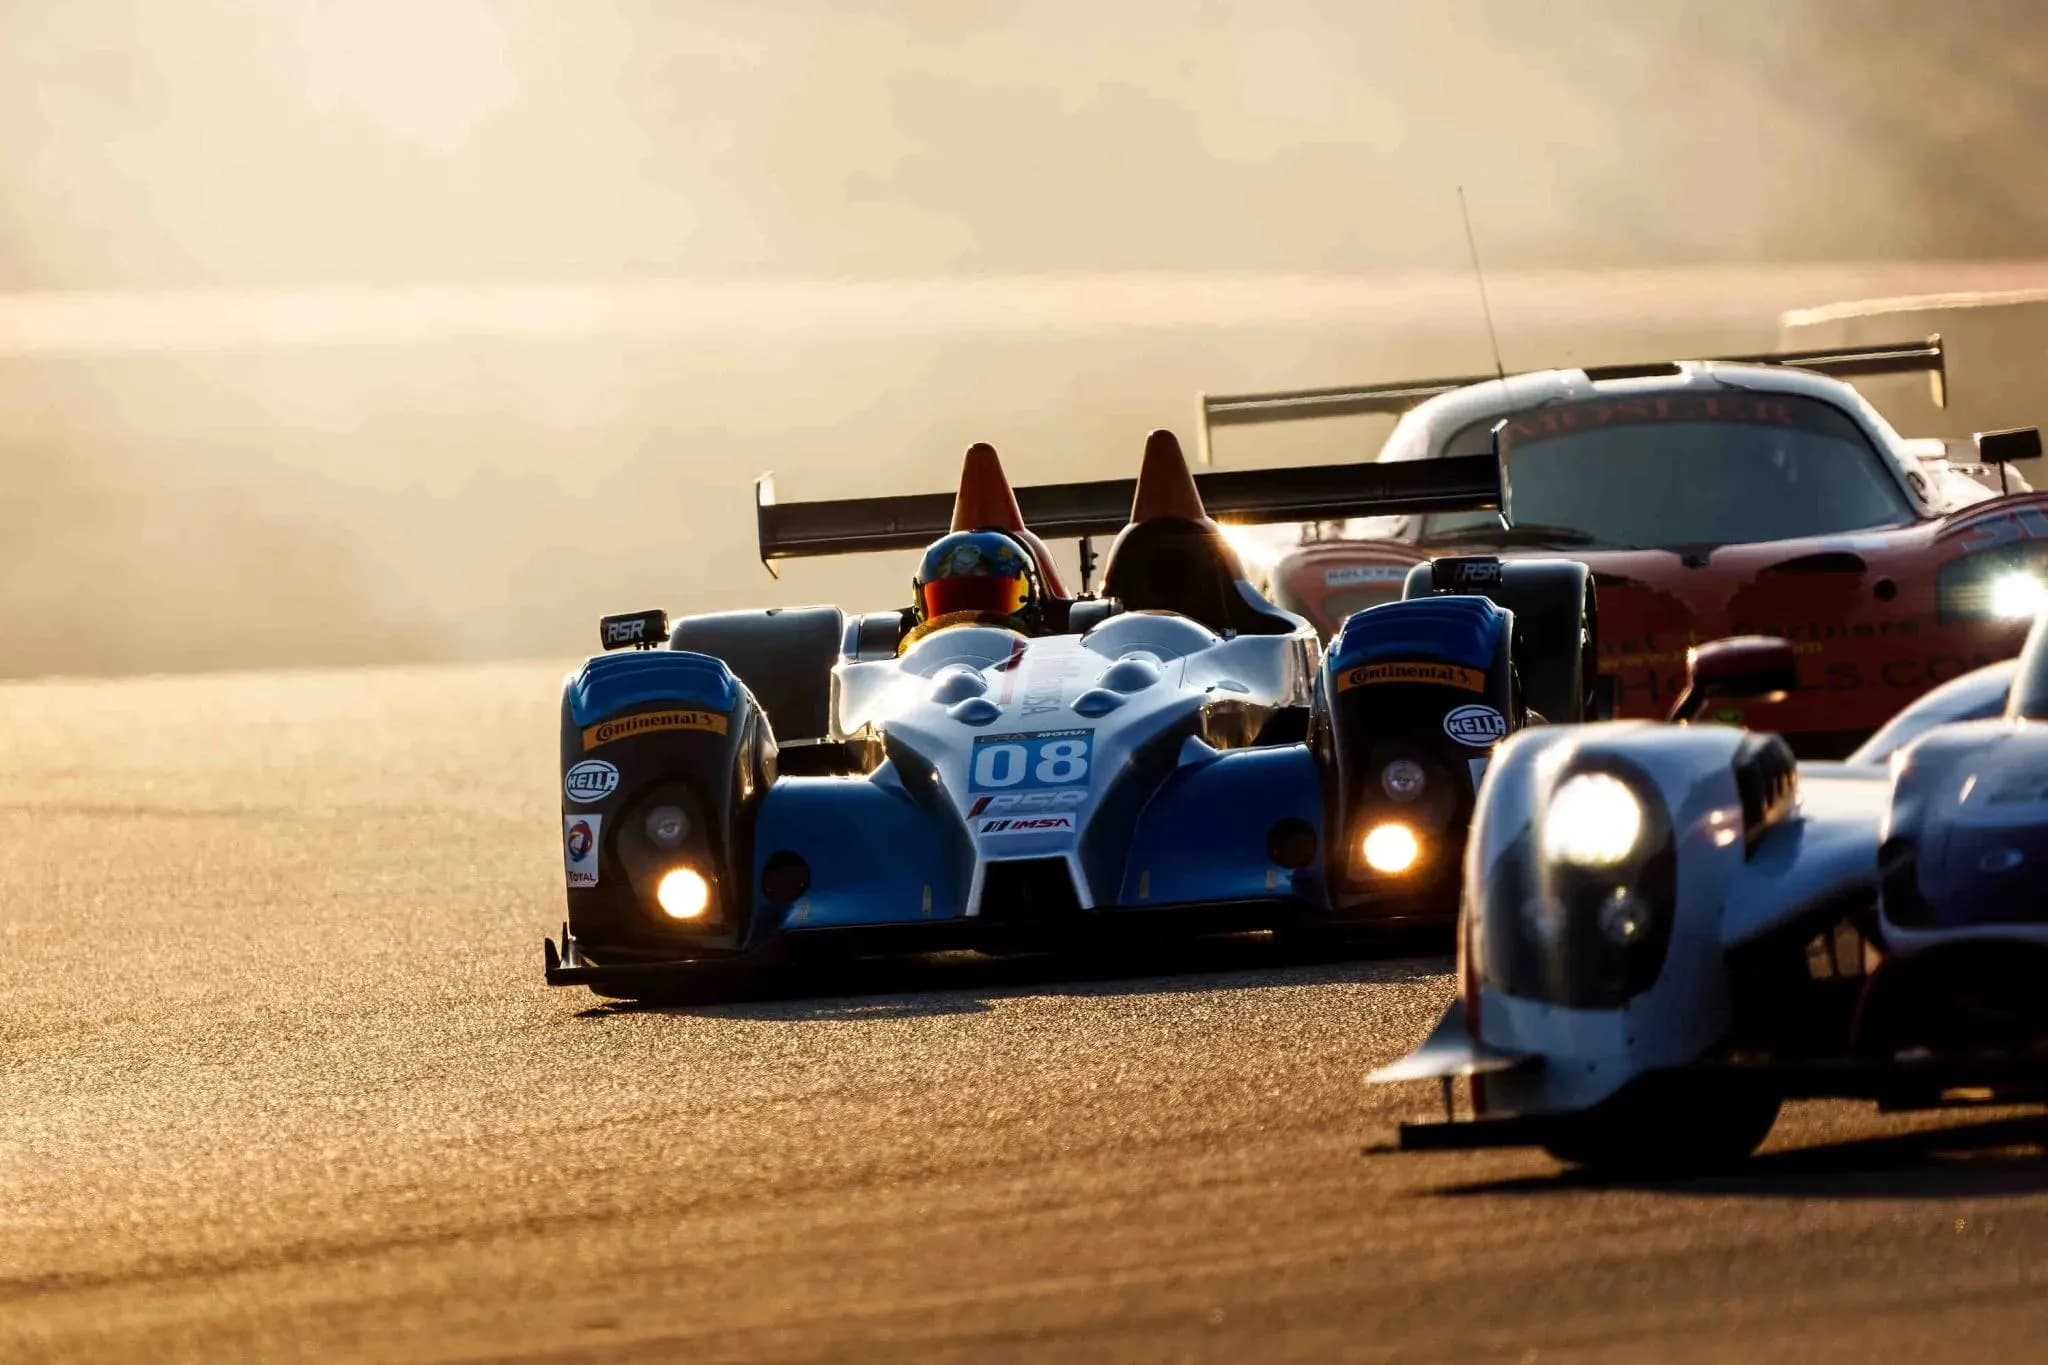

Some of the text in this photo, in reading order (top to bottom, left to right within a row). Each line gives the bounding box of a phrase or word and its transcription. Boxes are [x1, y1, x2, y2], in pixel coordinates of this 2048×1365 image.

[607, 619, 646, 643] RSR
[1349, 663, 1454, 686] Continental
[595, 711, 697, 742] Continental
[1449, 715, 1507, 737] HELLA
[974, 740, 1088, 787] 08
[566, 769, 621, 792] HELLA
[1011, 818, 1071, 830] IMSA
[567, 871, 597, 883] TOTAL
